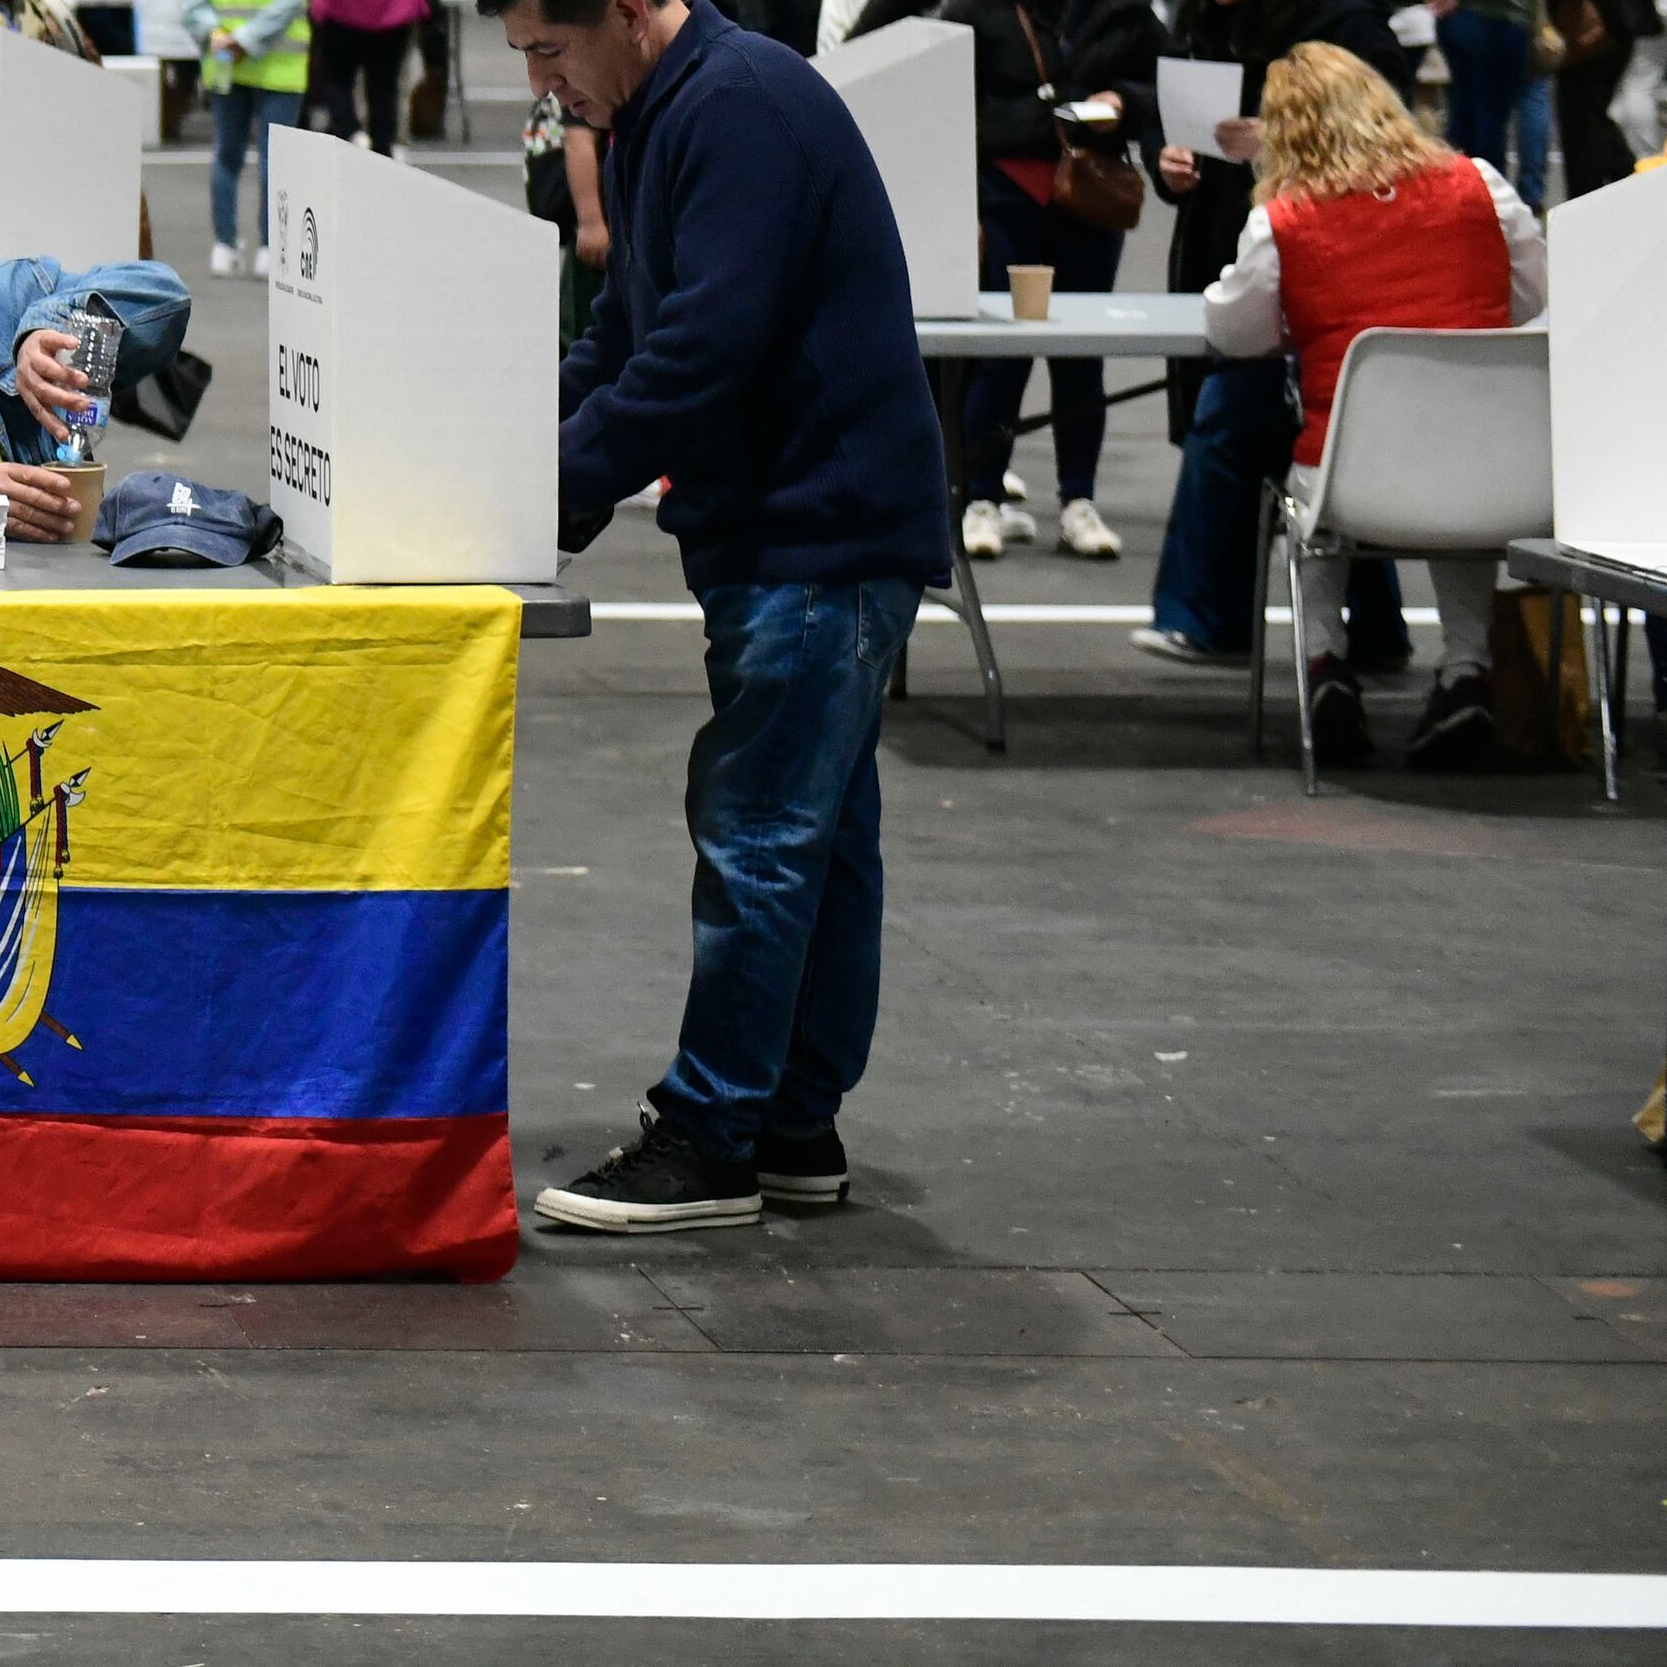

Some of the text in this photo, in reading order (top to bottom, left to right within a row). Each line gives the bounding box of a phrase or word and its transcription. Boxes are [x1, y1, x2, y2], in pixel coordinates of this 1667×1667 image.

[279, 344, 320, 413] EL VOTO
[270, 425, 332, 508] ES SECRETO
